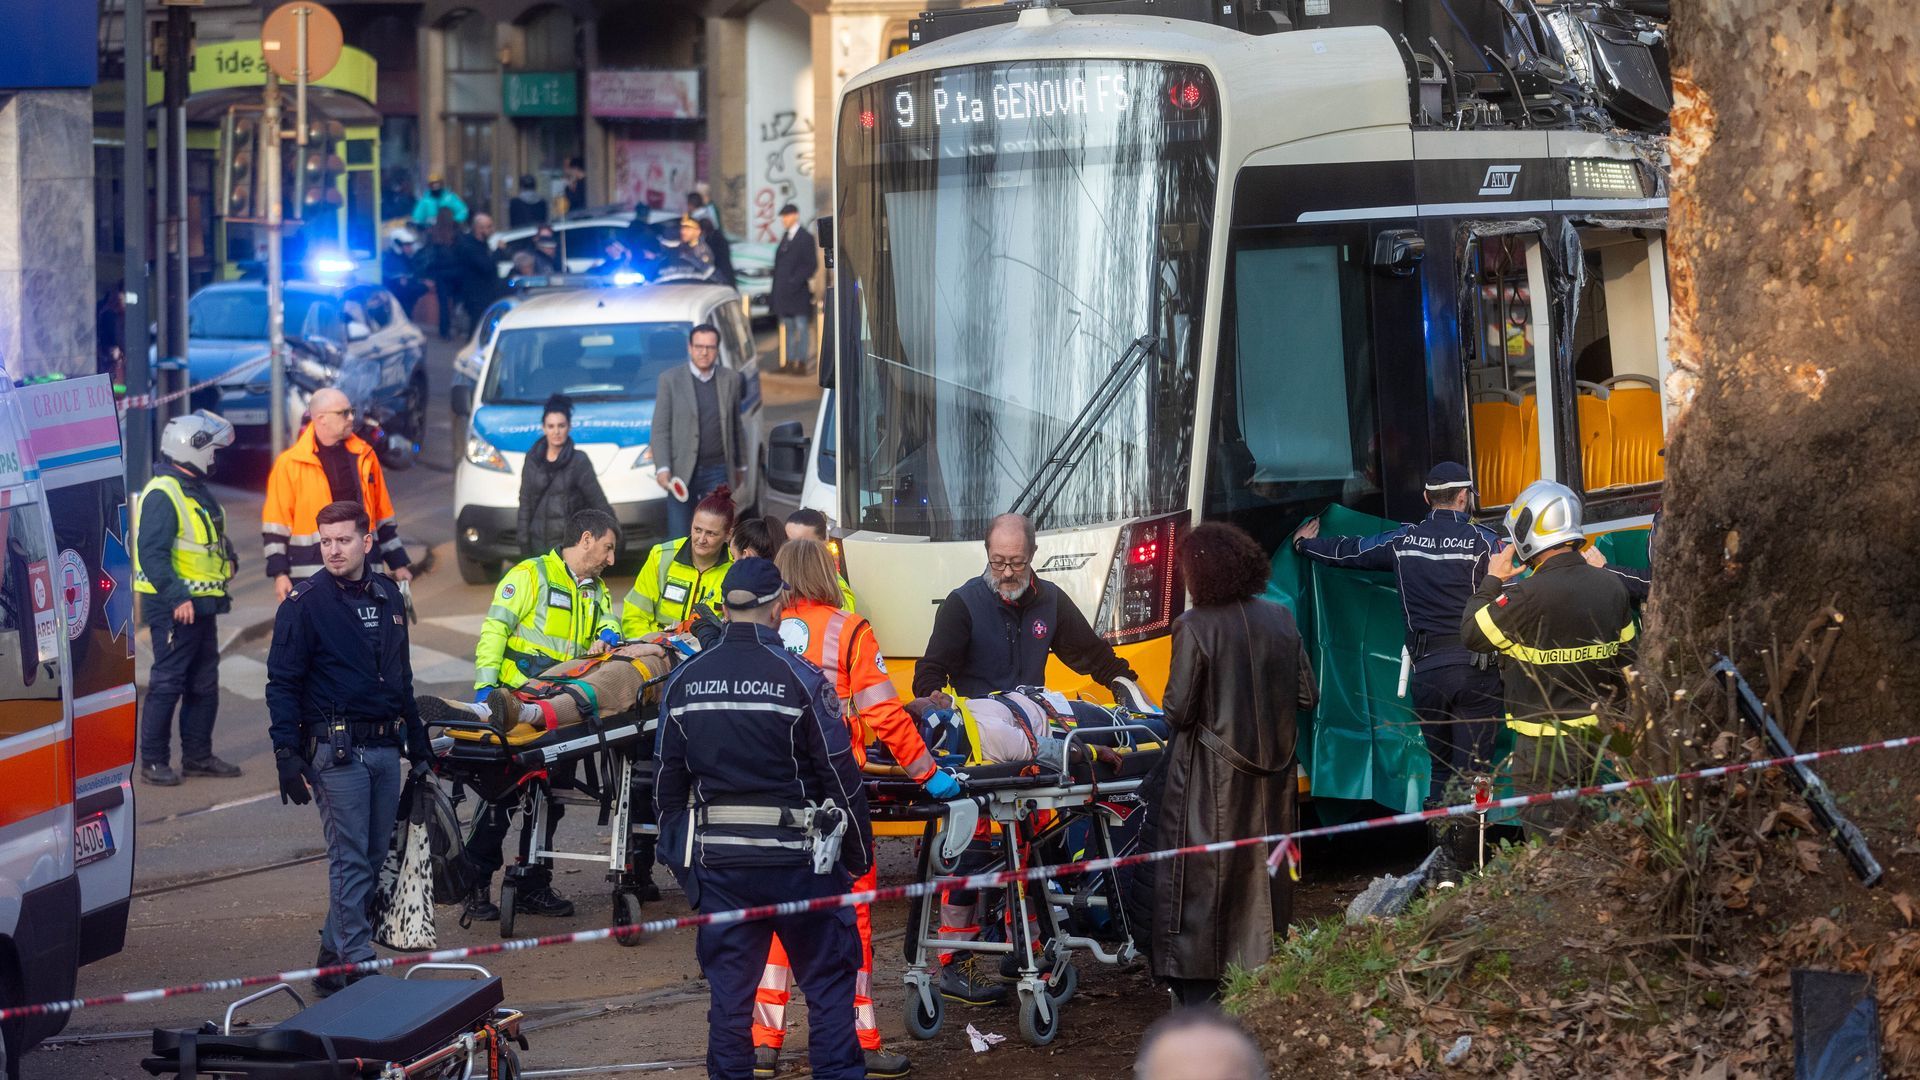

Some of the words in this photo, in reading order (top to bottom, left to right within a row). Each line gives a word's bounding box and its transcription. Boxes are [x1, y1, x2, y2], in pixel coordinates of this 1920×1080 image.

[896, 91, 914, 127] 9
[934, 88, 984, 125] P.ta
[993, 78, 1088, 120] GENOVA
[1096, 74, 1129, 112] FS
[1491, 173, 1509, 187] ATM
[33, 388, 81, 418] CROCE
[1439, 537, 1475, 549] LOCALE
[1054, 558, 1078, 568] ATM
[36, 619, 56, 638] AREU
[1538, 650, 1573, 663] VIGILI
[1575, 646, 1593, 661] DEL
[685, 680, 729, 697] POLIZIA
[733, 680, 786, 699] LOCALE
